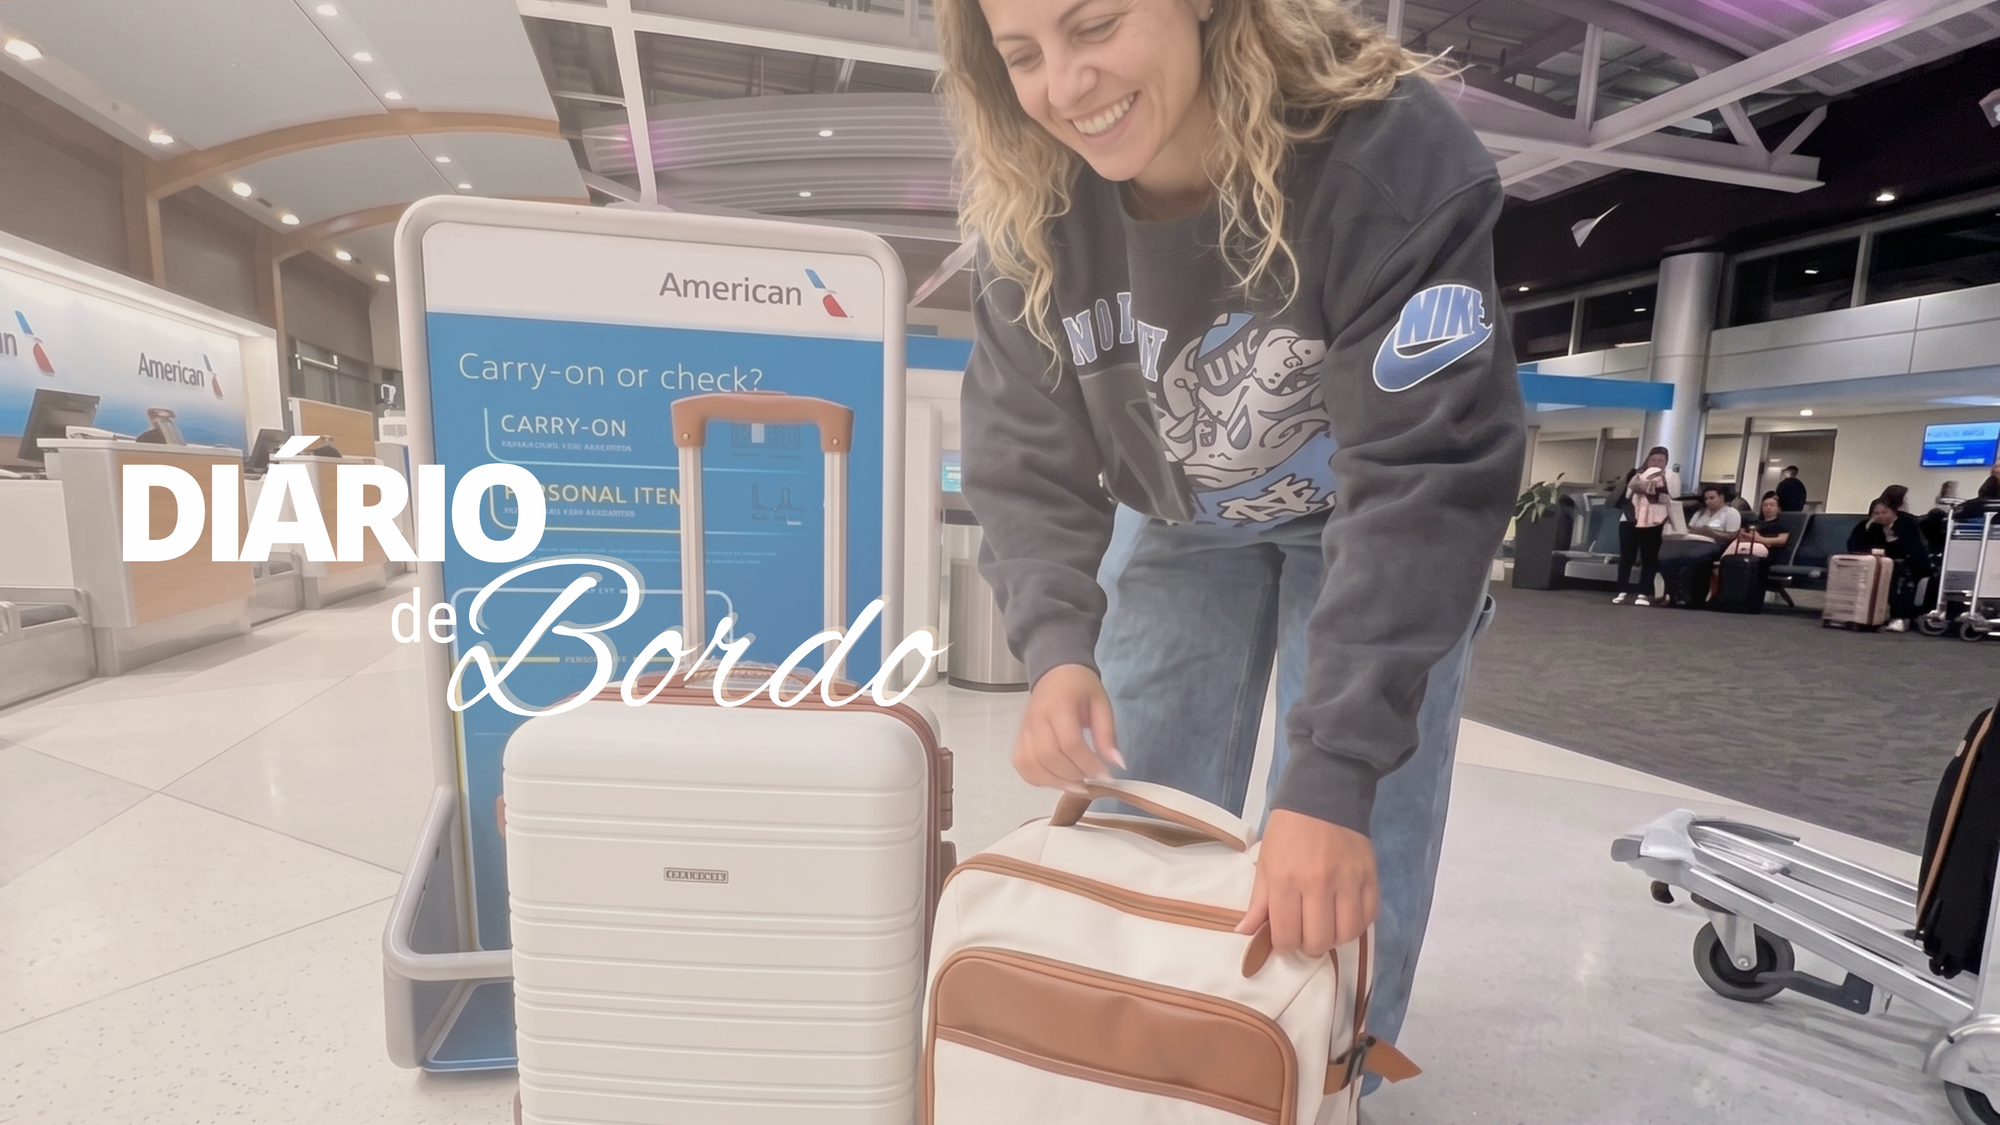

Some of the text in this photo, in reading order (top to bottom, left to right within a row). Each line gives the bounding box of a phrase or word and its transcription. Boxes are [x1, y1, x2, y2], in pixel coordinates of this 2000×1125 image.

[659, 272, 802, 306] American
[1394, 284, 1485, 348] NIKE
[138, 352, 205, 387] American
[459, 352, 763, 393] Carry-on or check?
[1203, 328, 1259, 387] UNC
[501, 414, 627, 437] CARRY-ON
[504, 482, 627, 504] PSONAL
